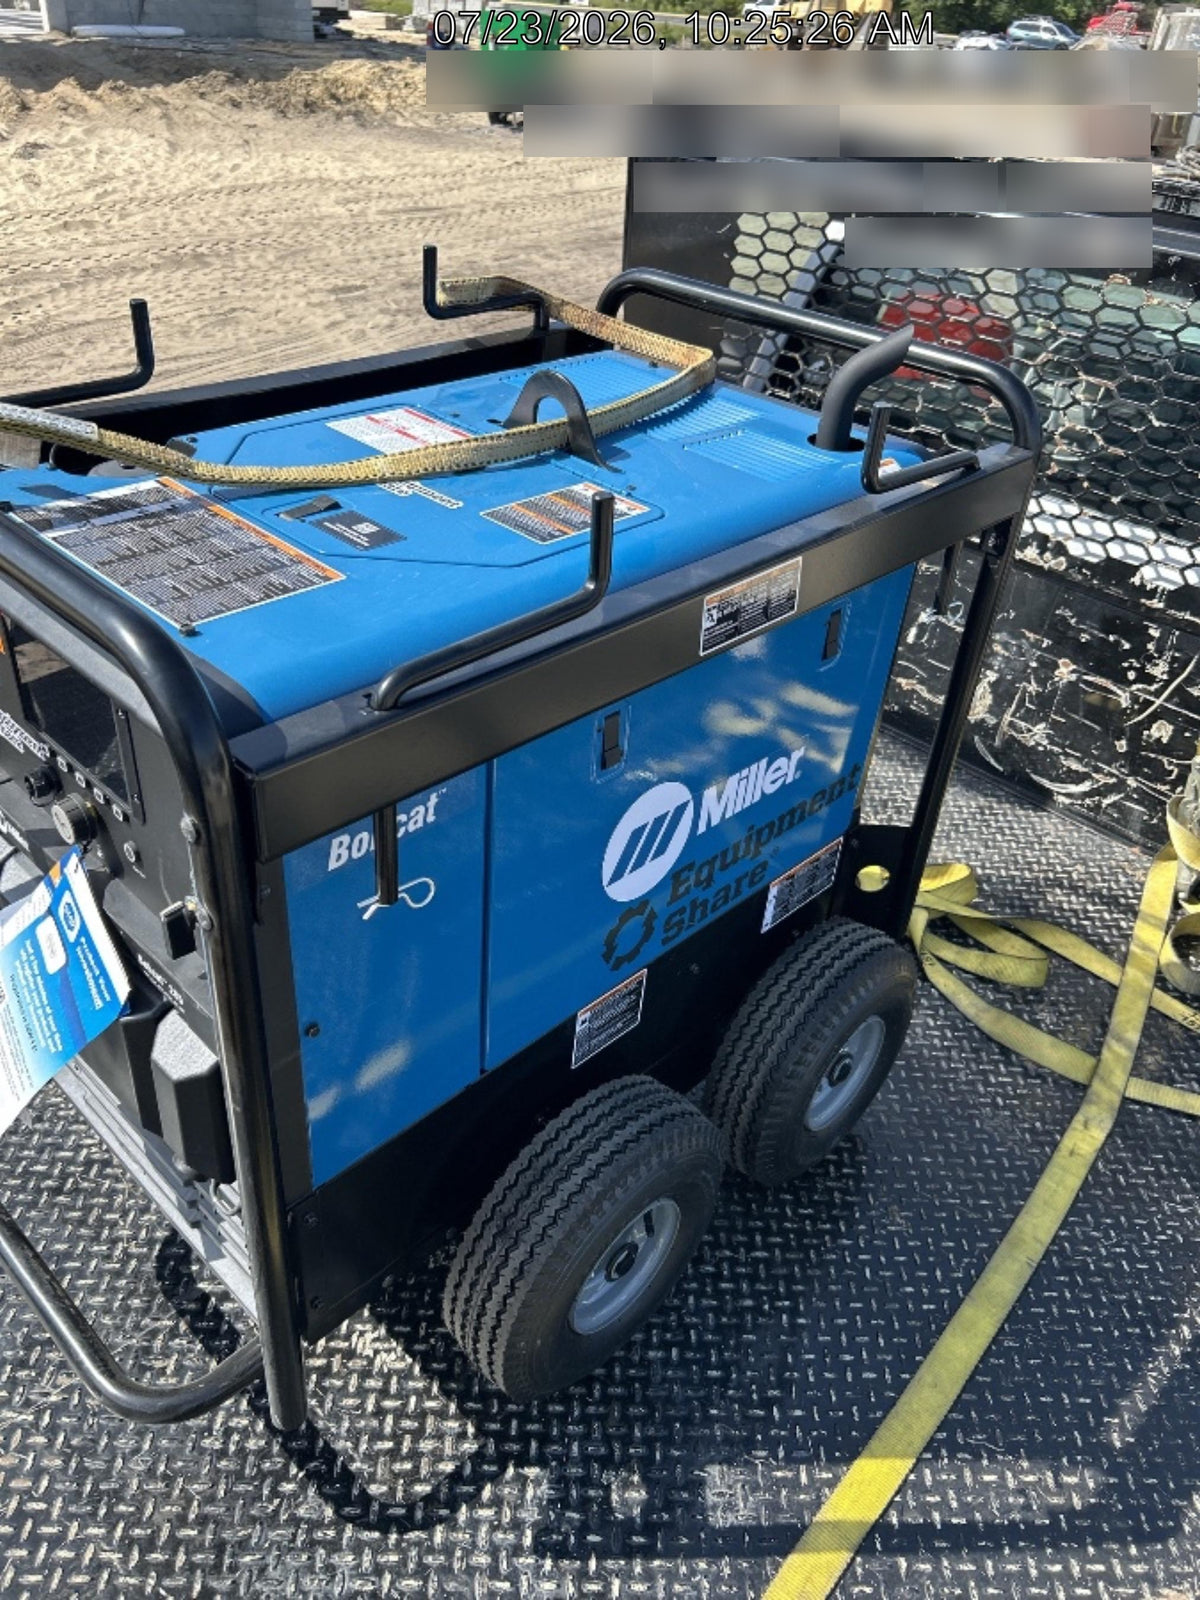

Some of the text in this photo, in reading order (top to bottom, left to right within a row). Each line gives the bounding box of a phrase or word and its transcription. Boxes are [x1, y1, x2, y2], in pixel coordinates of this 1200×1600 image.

[667, 763, 861, 906] Equipment
[697, 746, 804, 836] Miller
[661, 860, 770, 946] Share
